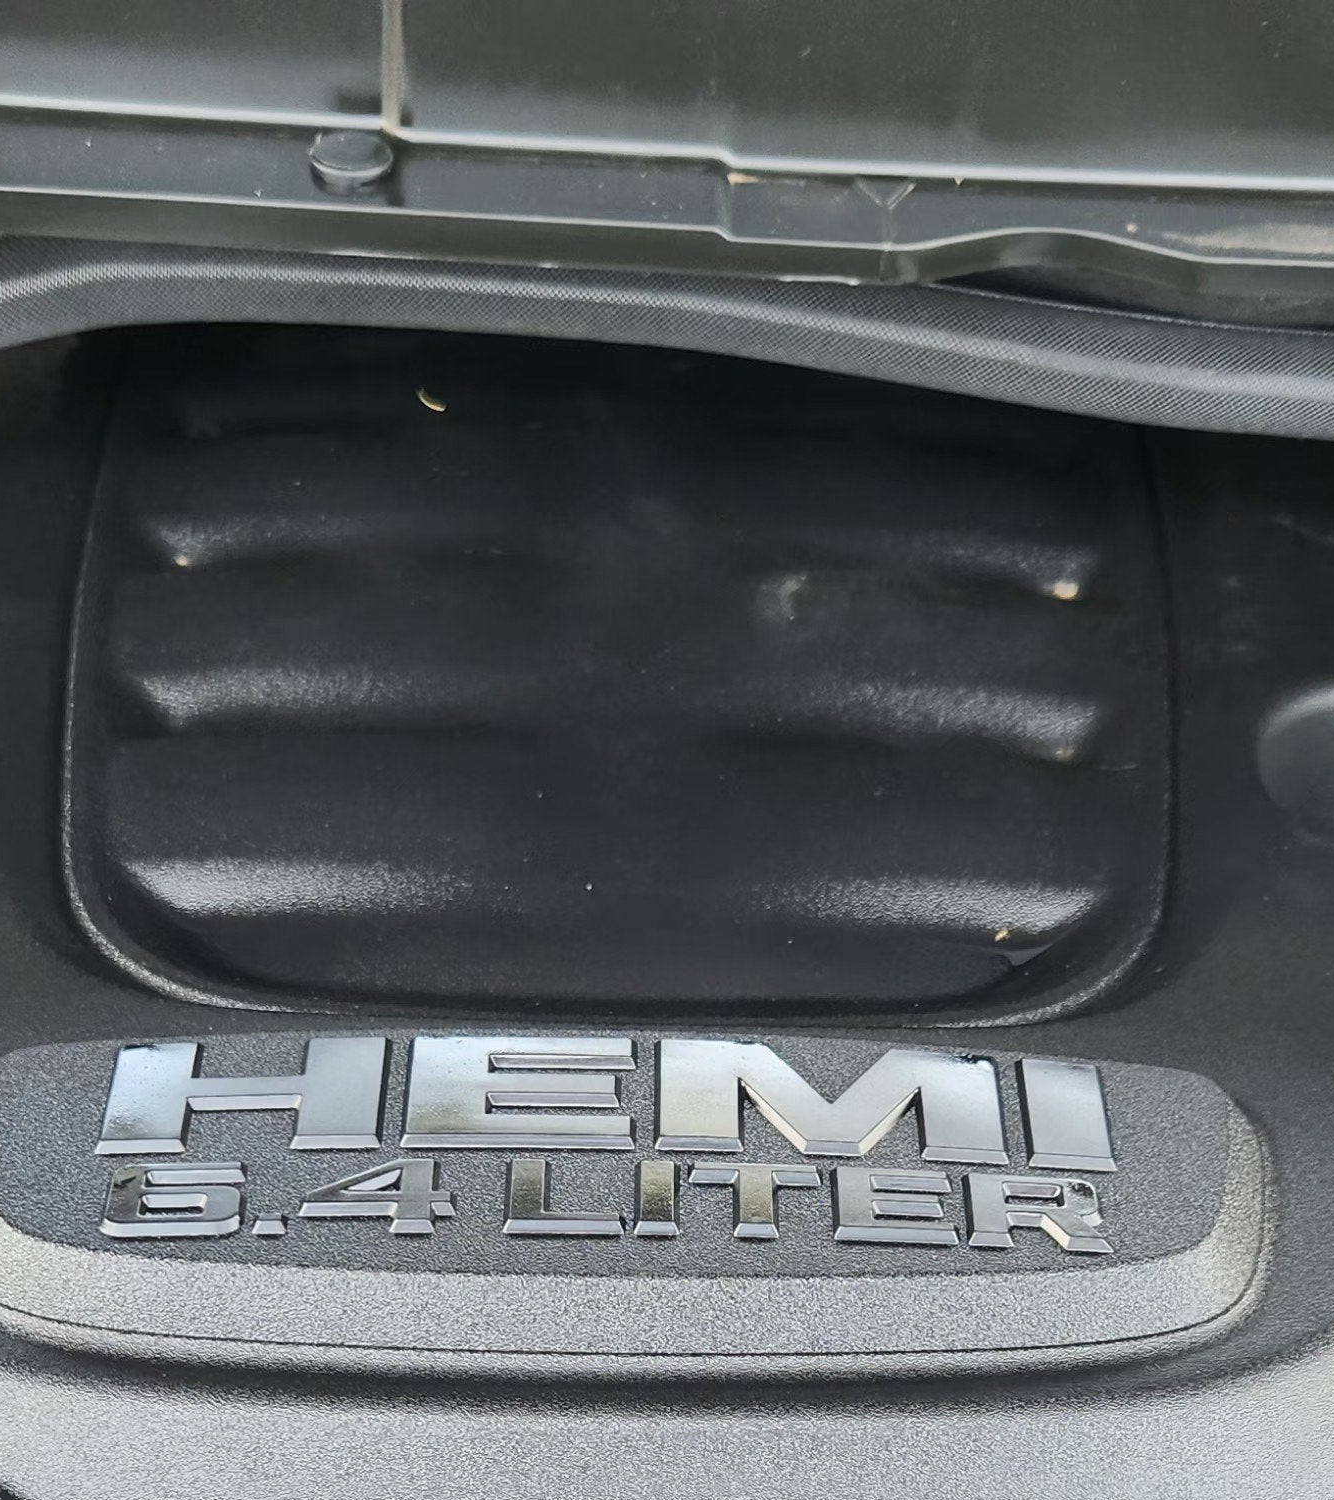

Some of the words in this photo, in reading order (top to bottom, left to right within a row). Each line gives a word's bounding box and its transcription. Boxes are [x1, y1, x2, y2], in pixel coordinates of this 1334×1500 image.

[94, 1036, 1118, 1171] HEMI
[97, 1158, 457, 1239] 6.4
[502, 1158, 1116, 1255] LITER
